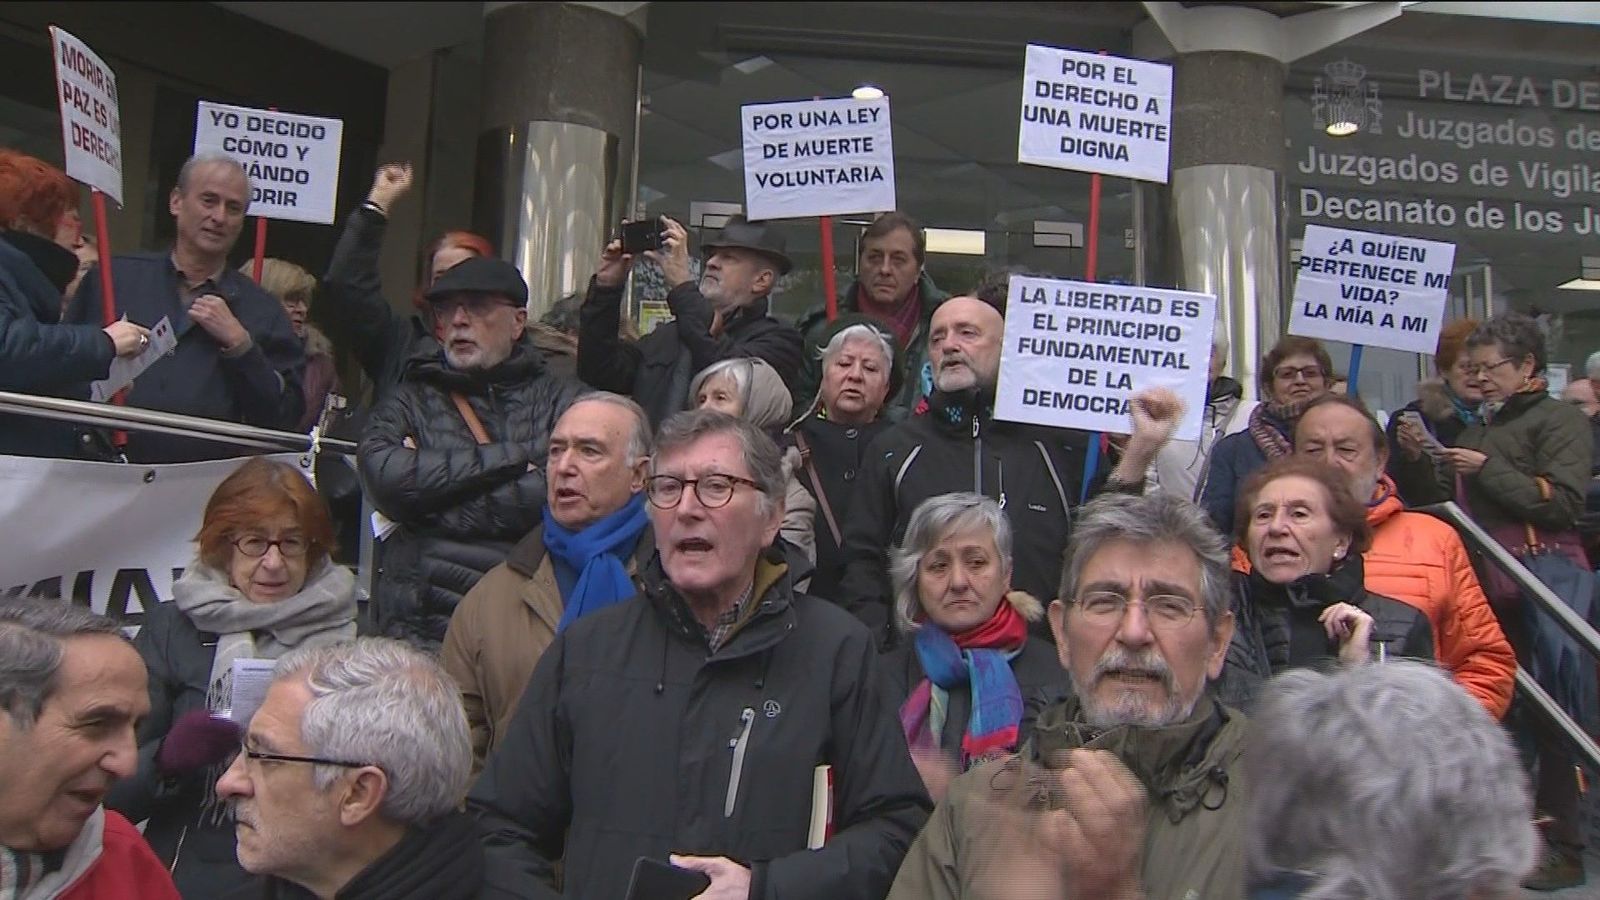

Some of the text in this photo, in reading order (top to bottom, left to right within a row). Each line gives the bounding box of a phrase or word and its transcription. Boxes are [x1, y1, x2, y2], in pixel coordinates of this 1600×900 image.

[61, 40, 104, 91] MORIR
[1061, 59, 1138, 85] POR EL
[62, 79, 91, 117] PAZ
[94, 97, 107, 128] ES
[1035, 80, 1159, 115] DERECHO A
[1418, 69, 1600, 110] PLAZA DE
[210, 110, 325, 140] YO DECIDO
[753, 107, 880, 131] POR UNA LEY
[1023, 105, 1167, 142] UNA MUERTE
[1397, 111, 1600, 150] Juzgados de
[71, 119, 120, 172] DERECH
[223, 135, 310, 161] CÓMO Y
[763, 137, 874, 159] DE MUERTE
[1060, 136, 1129, 162] DIGNA
[242, 160, 309, 184] ÁNDO
[755, 166, 884, 189] VOLUNTARIA
[1298, 146, 1459, 185] Juzgados
[1468, 158, 1509, 186] de
[251, 188, 297, 207] ORIR
[1300, 188, 1456, 226] Decanato
[1465, 200, 1504, 229] de
[1514, 202, 1563, 233] los
[1328, 238, 1354, 256] ¿A
[1299, 255, 1451, 290] PERTENECE MI
[1020, 286, 1200, 318] LA LIBERTAD ES
[1340, 283, 1400, 306] VIDA?
[1033, 313, 1181, 342] EL PRINCIPIO
[1303, 302, 1428, 334] LA MÍA A MI
[1018, 337, 1191, 370] FUNDAMENTAL
[1068, 367, 1133, 390] DE LA
[1022, 388, 1132, 416] DEMOCRA
